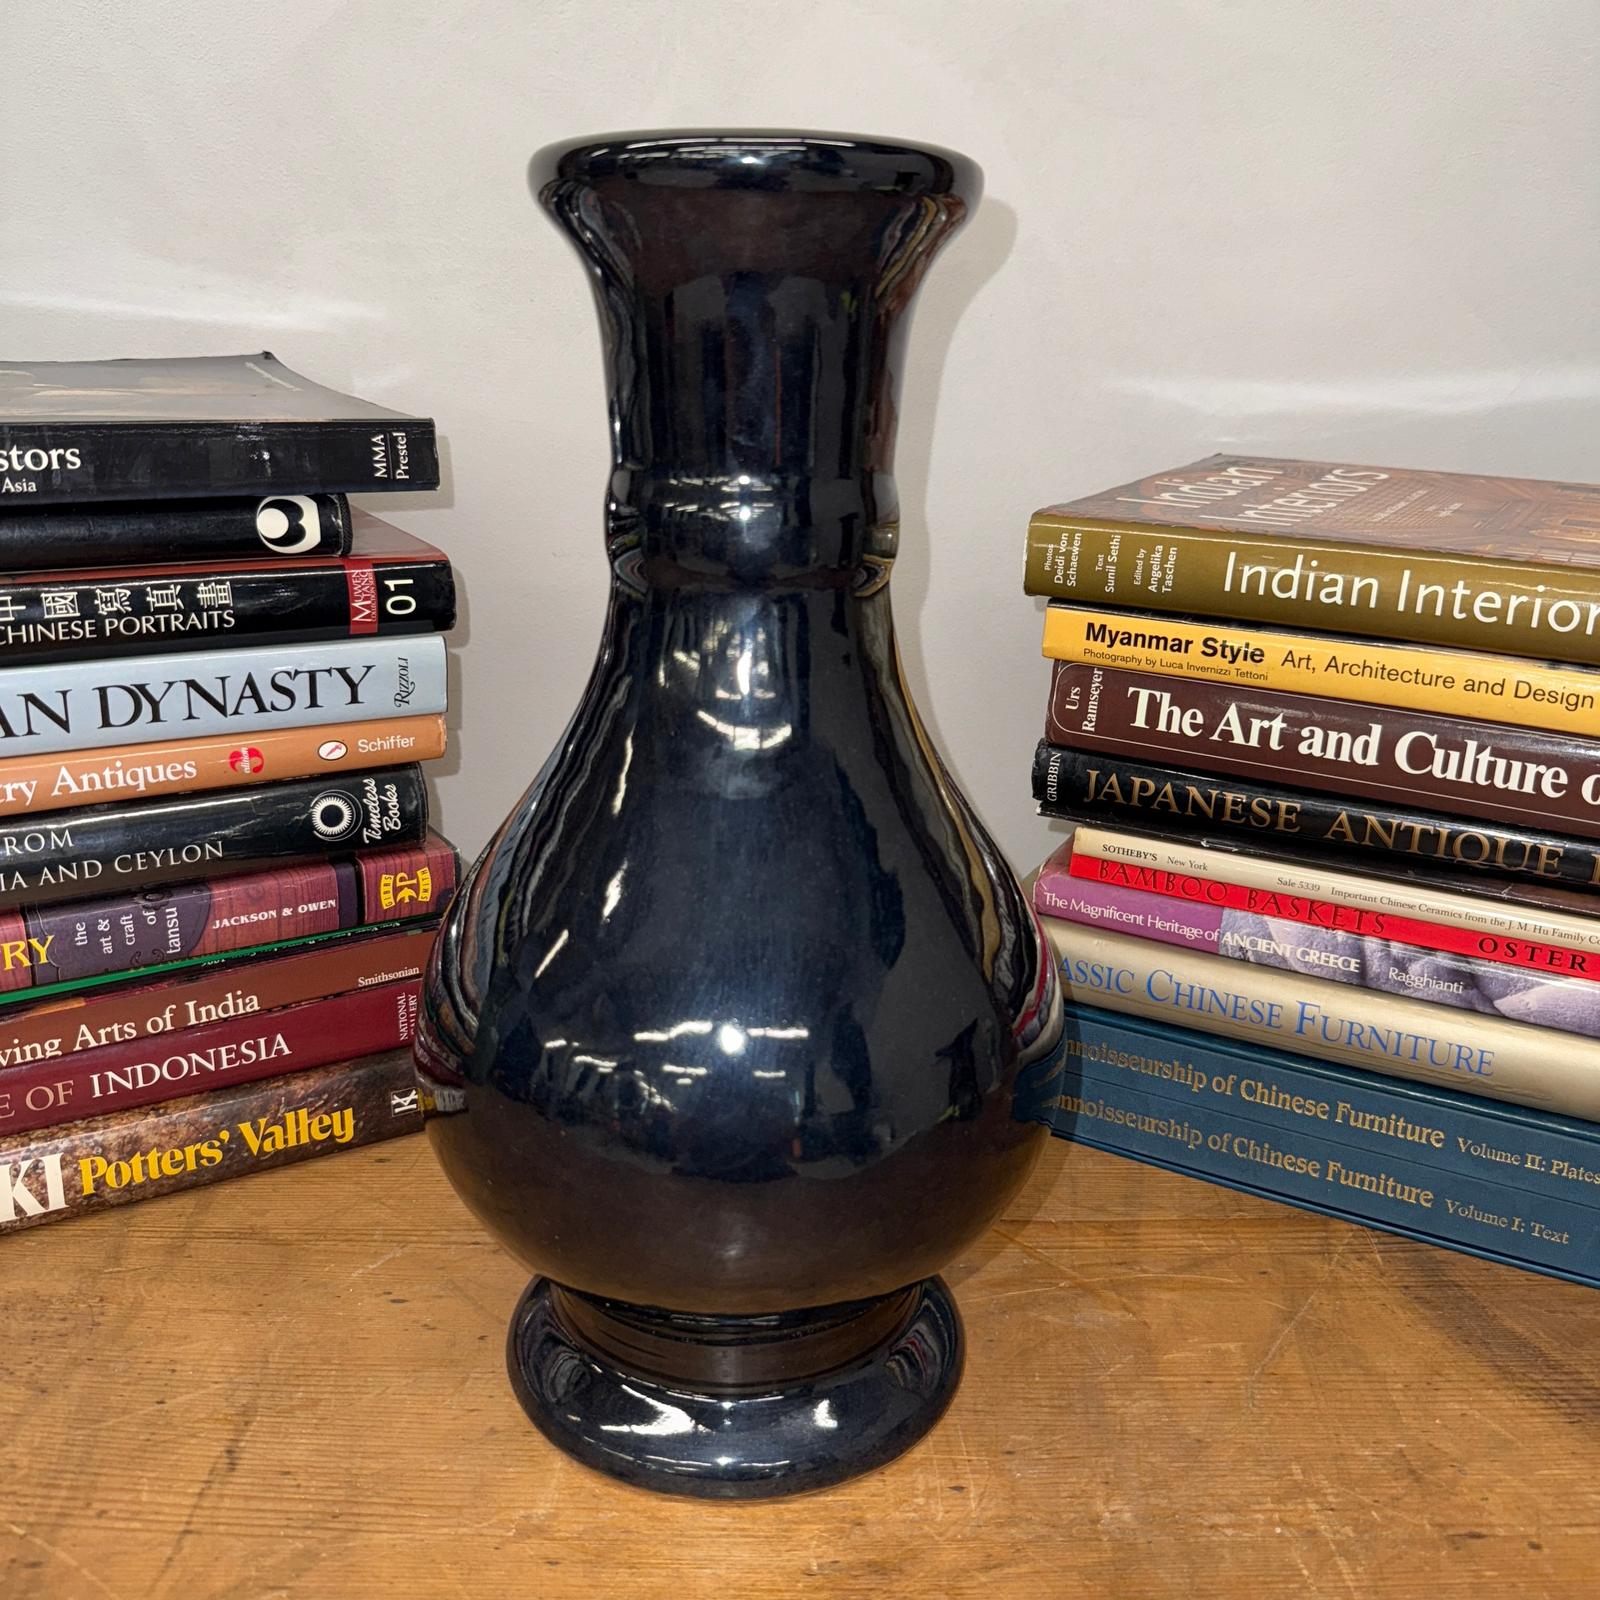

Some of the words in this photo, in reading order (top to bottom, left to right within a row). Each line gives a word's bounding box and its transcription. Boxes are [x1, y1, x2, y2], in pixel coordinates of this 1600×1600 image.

[0, 444, 81, 471] stors
[371, 434, 388, 478] MMA
[392, 431, 410, 480] Prestel
[2, 476, 37, 493] Asia
[1116, 466, 1283, 509] Indian
[1200, 469, 1389, 526] Interiors
[1044, 543, 1054, 571] Photos
[1059, 532, 1069, 553] von
[1067, 532, 1083, 587] Schaewen
[1095, 554, 1105, 572] Text
[1108, 534, 1122, 563] Sethi
[1137, 548, 1147, 559] by
[1054, 555, 1065, 584] Deidi
[1105, 563, 1117, 593] Sunil
[1134, 559, 1145, 585] Edited
[1148, 545, 1164, 593] Angelika
[1161, 546, 1178, 594] Taschen
[384, 579, 416, 615] 01
[1224, 552, 1379, 608] Indian
[1397, 570, 1600, 635] Interior
[105, 610, 235, 637] PORTRAITS
[1083, 648, 1143, 667] Photography
[1145, 656, 1157, 668] by
[1160, 657, 1183, 670] Luca
[1186, 661, 1231, 676] Invernizzi
[1235, 667, 1269, 681] Tettoni
[1085, 622, 1193, 654] Myanmar
[1201, 636, 1265, 665] Style
[1281, 650, 1316, 673] Art,
[1323, 655, 1456, 690] Architecture
[1463, 677, 1505, 697] and
[1513, 679, 1594, 712] Design
[92, 664, 376, 730] DYNASTY
[1065, 686, 1082, 712] Urs
[1082, 668, 1104, 733] Ramseyer
[358, 736, 415, 753] Schiffer
[1127, 686, 1204, 737] The
[1209, 702, 1287, 751] Art
[1298, 723, 1383, 767] and
[1394, 730, 1568, 799] Culture
[51, 760, 197, 797] Antiques
[1047, 752, 1062, 802] GRIBBIN
[363, 778, 382, 844] Timeless
[380, 783, 401, 831] Books
[1083, 769, 1300, 833] JAPANESE
[1322, 810, 1564, 878] ANTIQUE
[4, 829, 75, 856] ROM
[38, 859, 102, 886] AND
[114, 841, 223, 873] CEYLON
[420, 870, 430, 900] SMITH
[1102, 843, 1158, 862] SOTHEBY'S
[1167, 855, 1186, 867] New
[1189, 857, 1208, 872] York
[1277, 876, 1296, 888] Sale
[1298, 880, 1321, 893] 5339
[1331, 886, 1377, 904] Important
[1380, 895, 1416, 911] Chinese
[1418, 903, 1463, 920] Ceramics
[1464, 911, 1488, 925] from
[1490, 916, 1505, 929] the
[1533, 925, 1549, 937] Hu
[1551, 927, 1586, 944] Family
[75, 921, 88, 946] the
[97, 919, 110, 931] &
[120, 913, 136, 945] craft
[143, 910, 157, 925] of
[165, 906, 181, 954] tansu
[212, 909, 277, 929] JACKSON
[282, 905, 293, 916] &
[298, 900, 336, 914] OWEN
[1100, 859, 1228, 901] BAMBOO
[1248, 888, 1386, 933] BASKETS
[1478, 937, 1588, 973] OSTER
[1, 935, 55, 971] RY
[99, 935, 113, 954] art
[1043, 892, 1068, 909] The
[1070, 897, 1145, 926] Magnificent
[1147, 910, 1203, 940] Heritage
[1204, 928, 1220, 942] of
[1222, 931, 1294, 958] ANCIENT
[1296, 947, 1360, 973] GREECE
[1389, 966, 1463, 994] Ragghianti
[358, 966, 420, 988] Smithsonian
[73, 1021, 137, 1051] Arts
[147, 1005, 176, 1035] of
[185, 990, 260, 1026] India
[397, 992, 408, 1041] NATIONAL
[1146, 969, 1283, 1029] CHINESE
[1294, 1000, 1495, 1077] FURNITURE
[26, 1080, 74, 1111] OF
[90, 1033, 292, 1098] INDONESIA
[238, 1107, 354, 1157] Valley
[1212, 1074, 1237, 1095] of
[1240, 1079, 1330, 1120] Chinese
[1336, 1101, 1445, 1148] Furniture
[1457, 1137, 1521, 1165] Volume
[1525, 1153, 1546, 1171] II:
[1551, 1160, 1600, 1185] Plates
[1208, 1133, 1232, 1153] of
[1233, 1137, 1321, 1178] Chinese
[1326, 1160, 1434, 1208] Furniture
[1444, 1199, 1508, 1229] Volume
[1511, 1217, 1525, 1233] I:
[1531, 1221, 1569, 1244] Text
